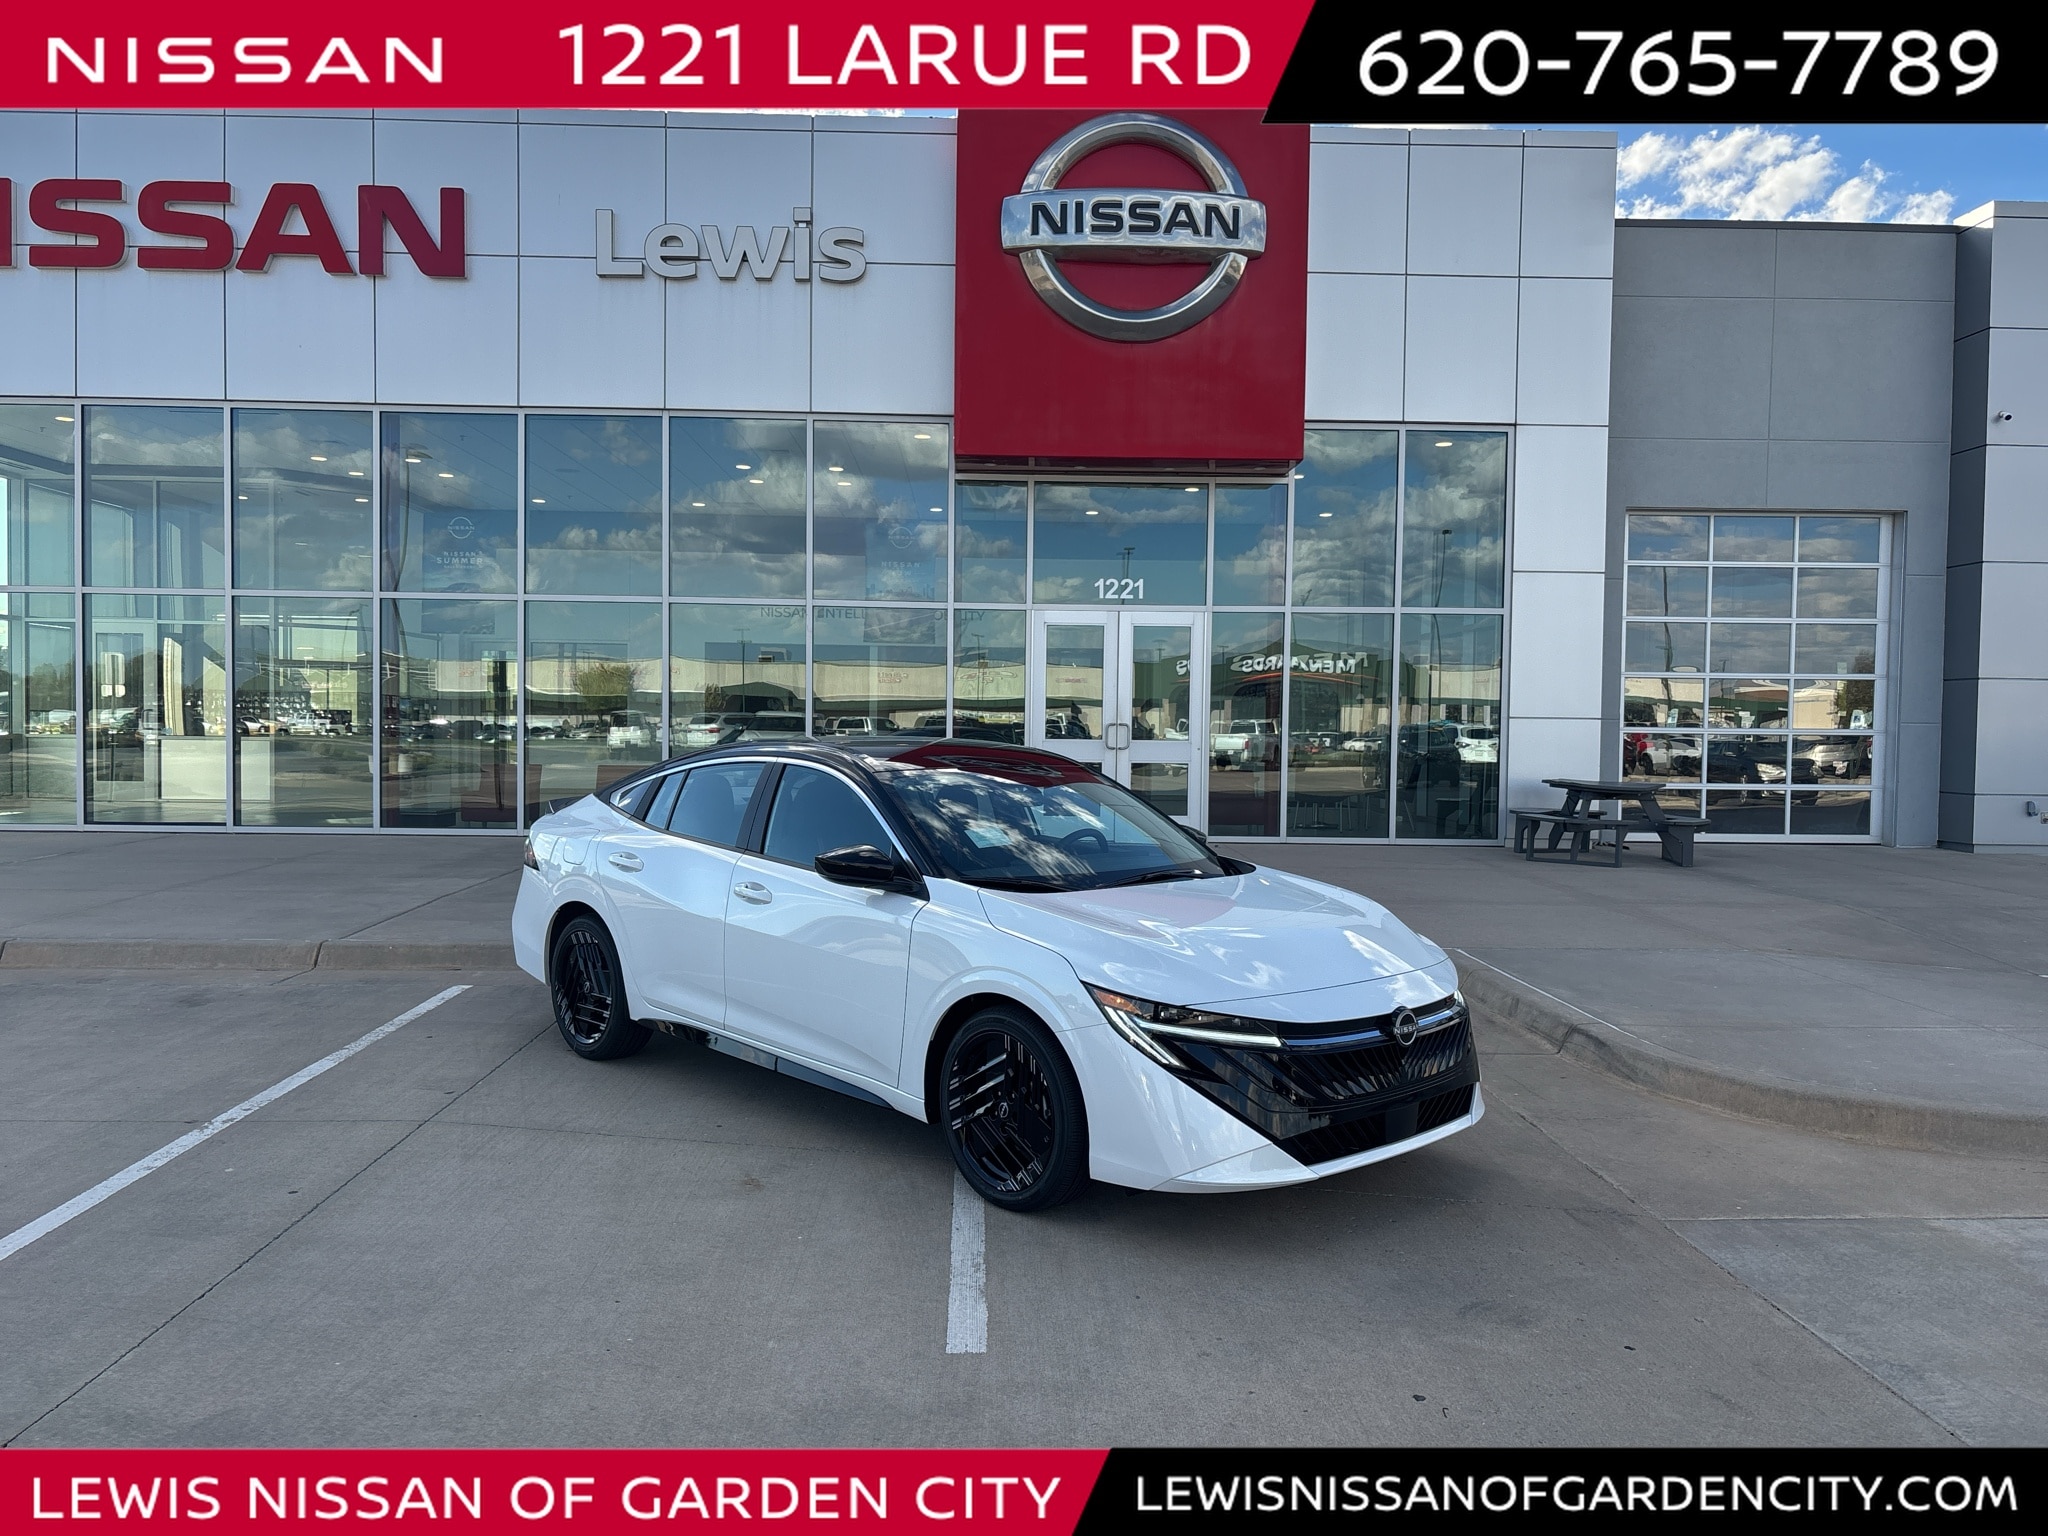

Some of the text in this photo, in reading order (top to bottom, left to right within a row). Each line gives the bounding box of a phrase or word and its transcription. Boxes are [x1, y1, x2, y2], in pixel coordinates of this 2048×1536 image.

[1030, 199, 1241, 240] NISSAN
[595, 206, 867, 284] Lewis
[1094, 578, 1144, 600] 1221
[1394, 1025, 1417, 1034] NISSA
